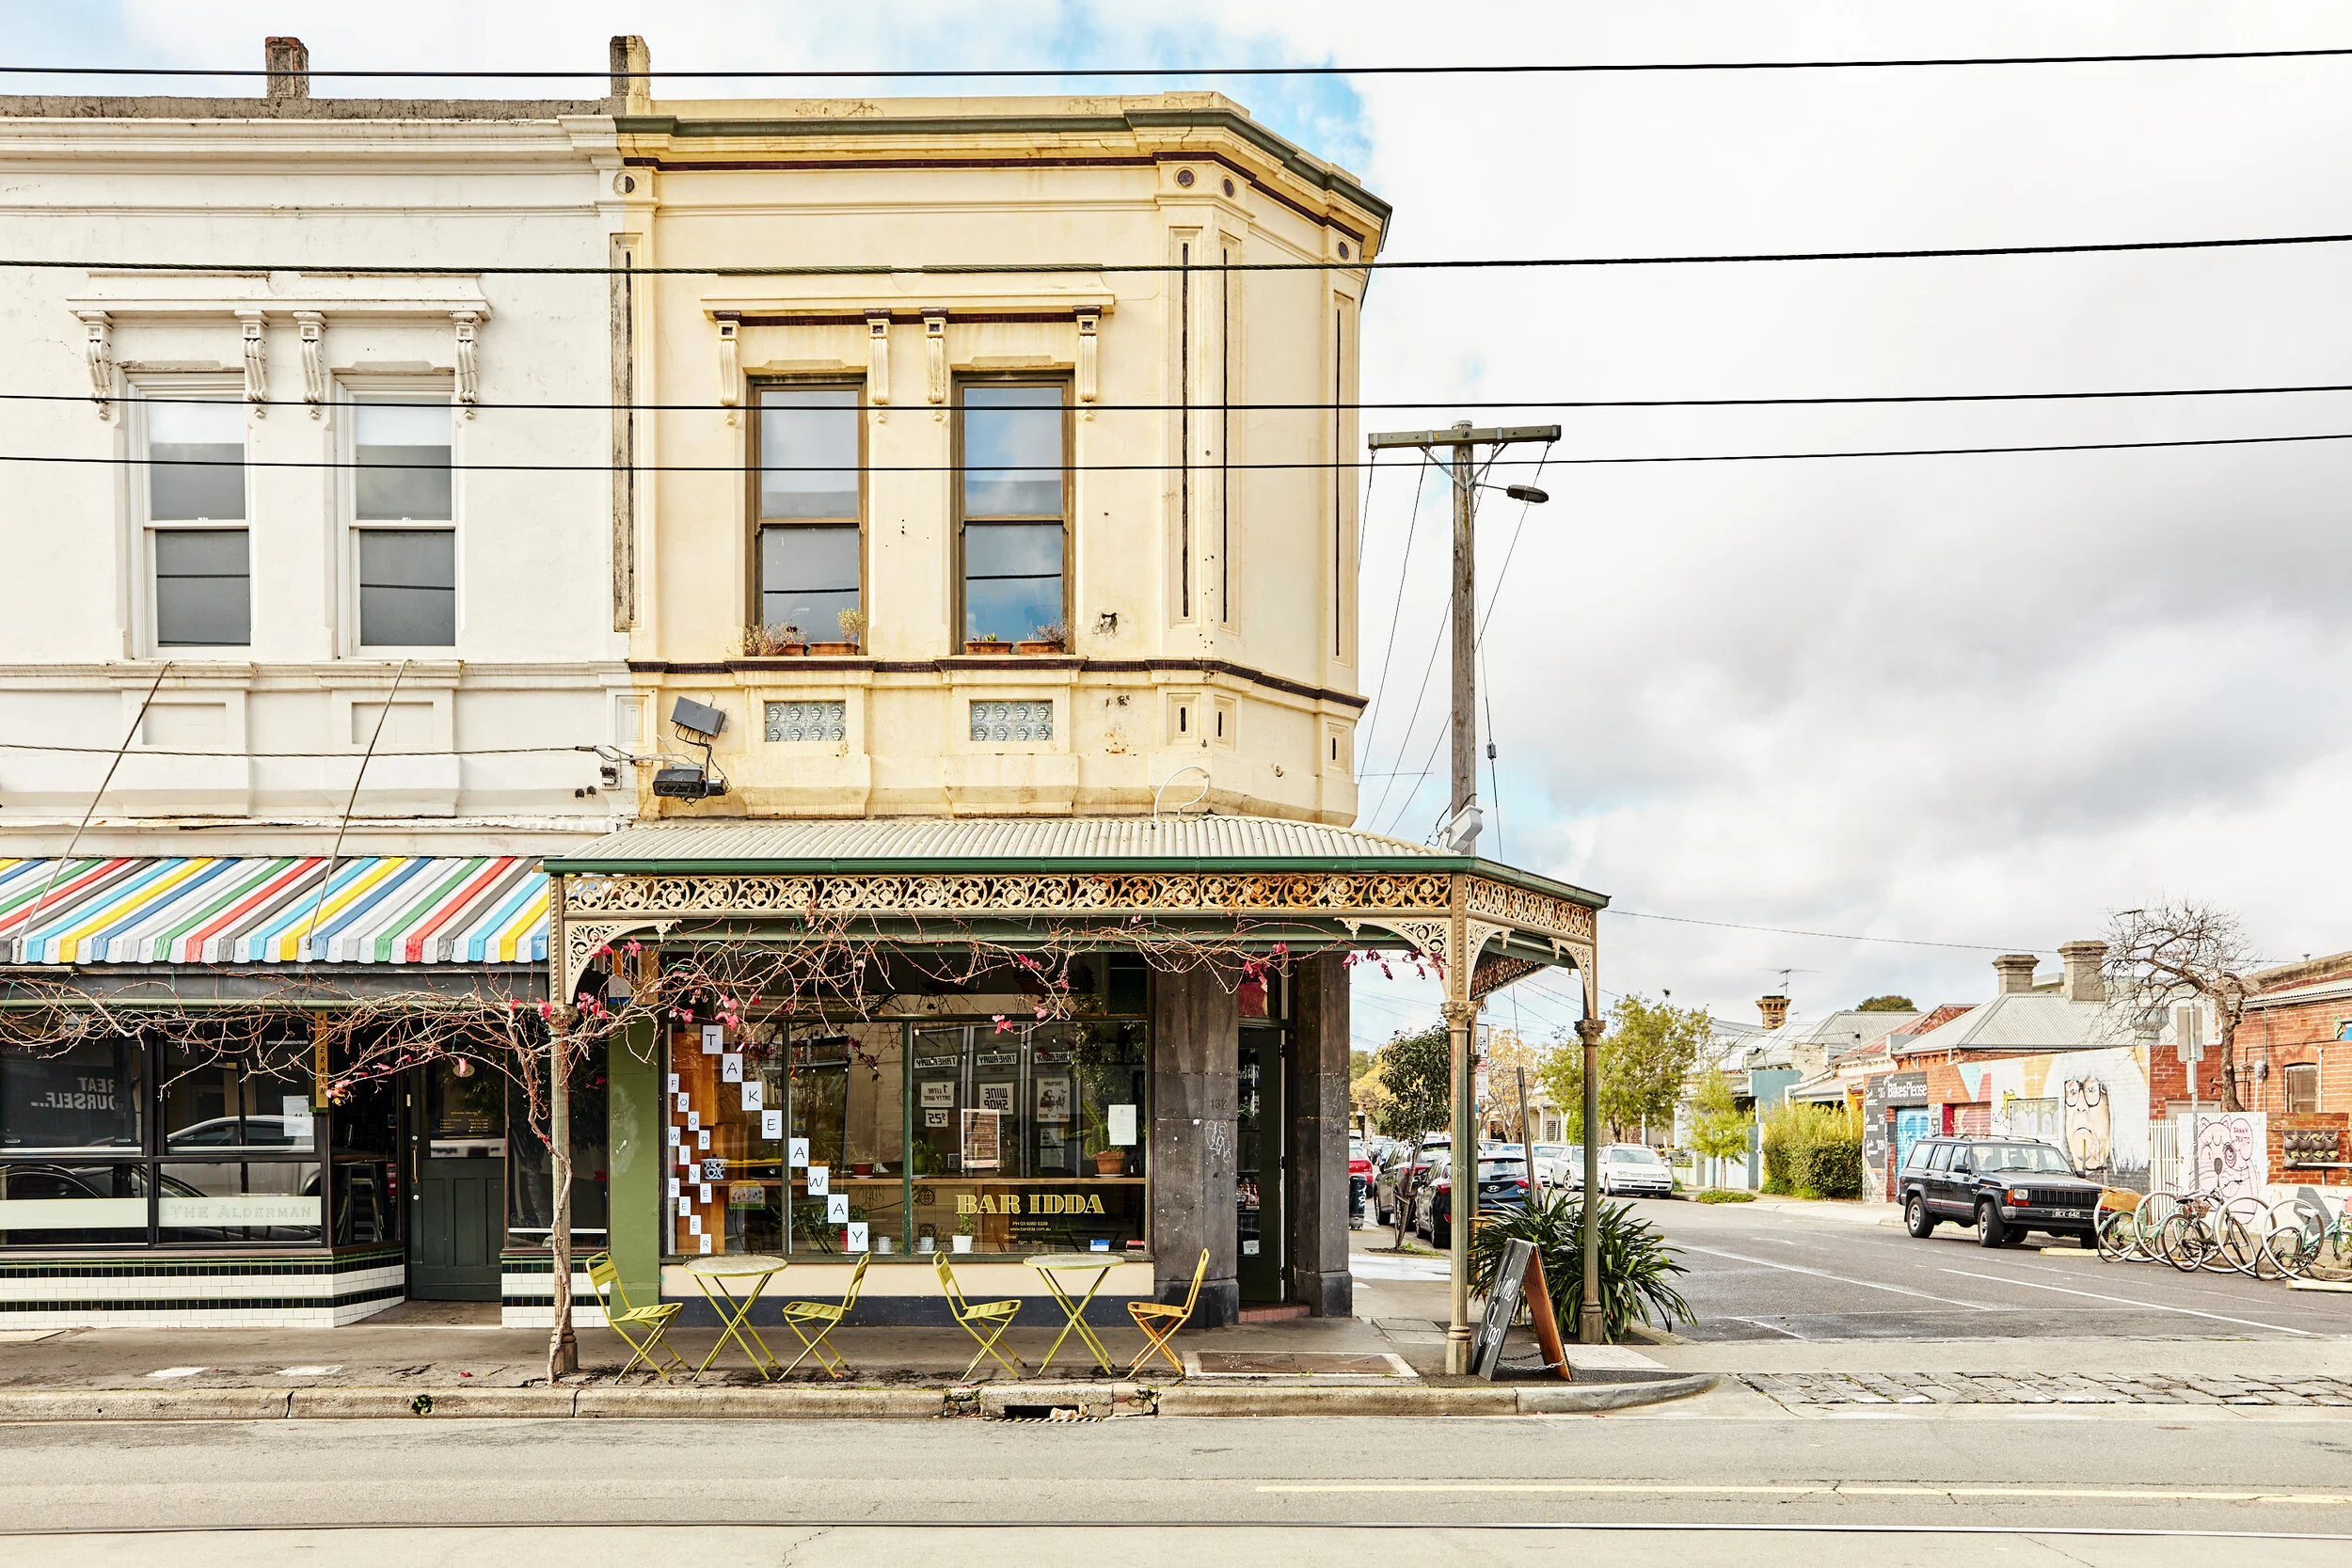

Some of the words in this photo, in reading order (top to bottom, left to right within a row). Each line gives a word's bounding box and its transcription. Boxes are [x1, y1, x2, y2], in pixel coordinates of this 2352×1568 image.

[319, 1014, 327, 1096] AERMN
[955, 1194, 1022, 1214] BAR
[1027, 1194, 1105, 1214] IDDA
